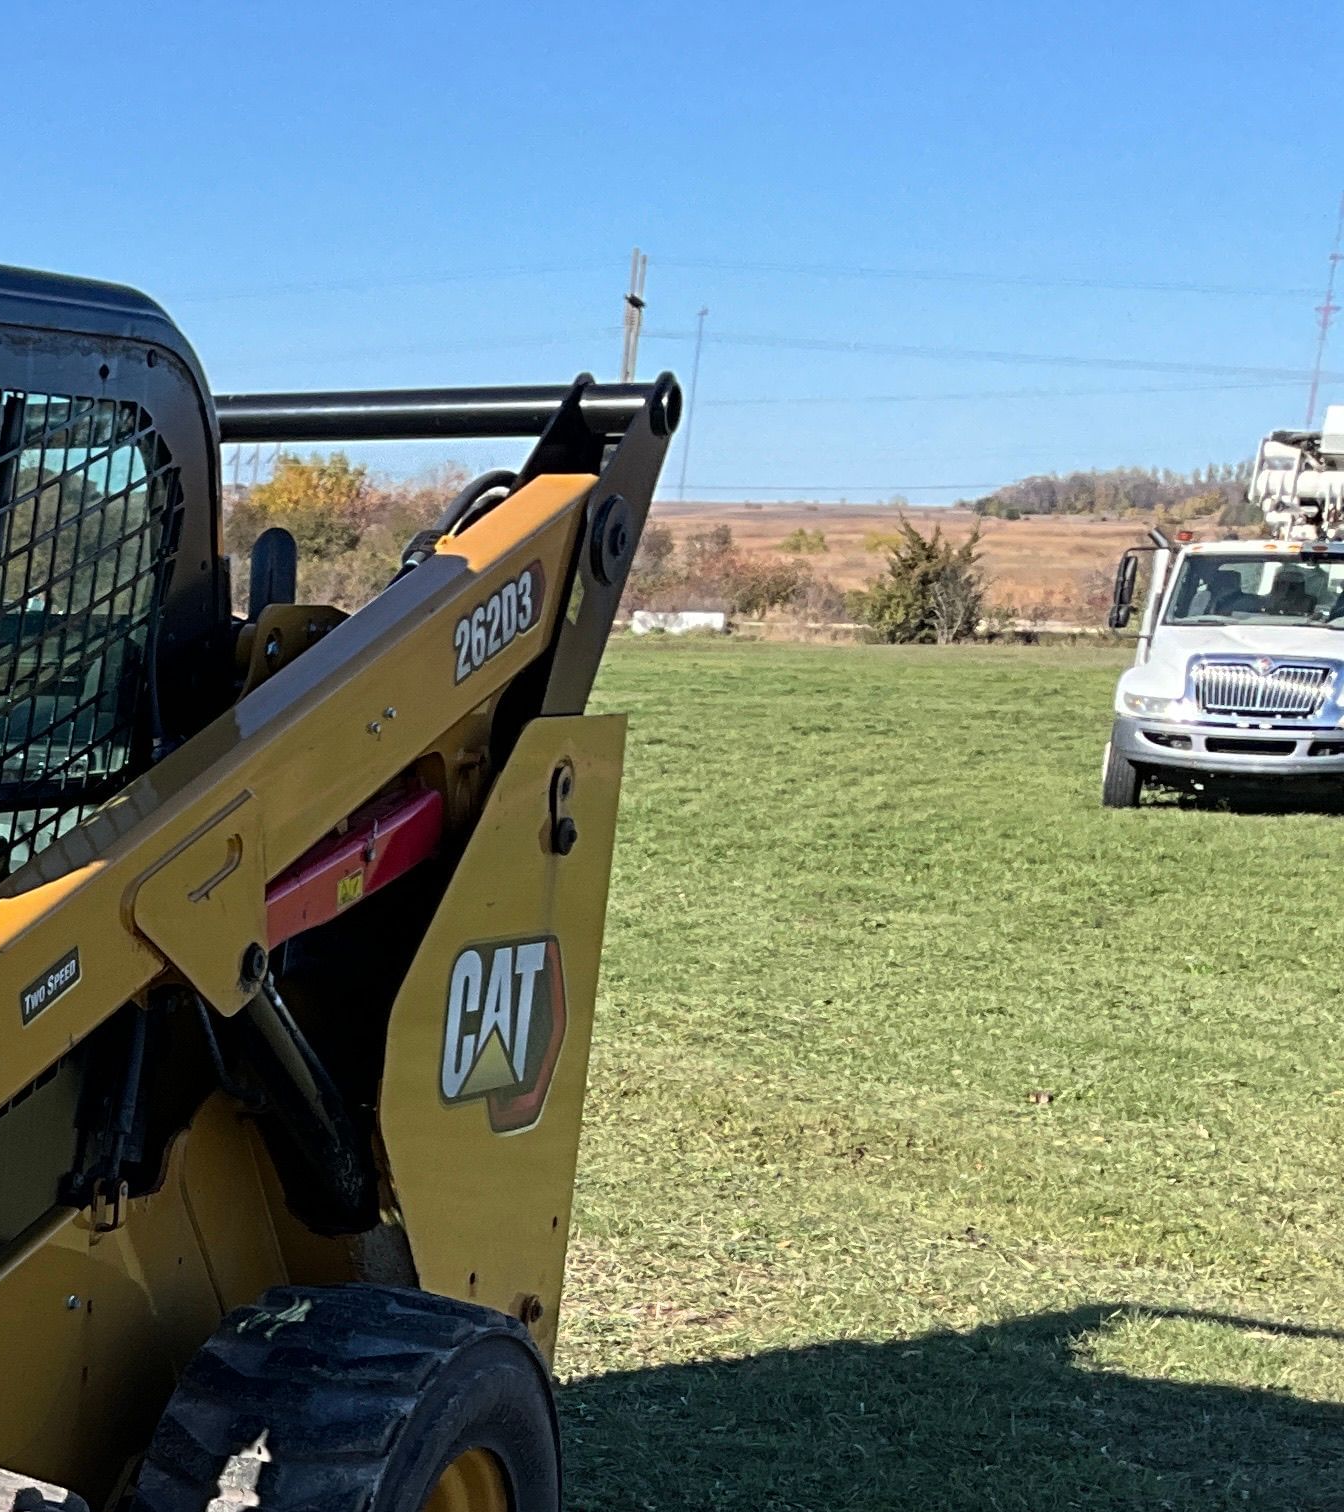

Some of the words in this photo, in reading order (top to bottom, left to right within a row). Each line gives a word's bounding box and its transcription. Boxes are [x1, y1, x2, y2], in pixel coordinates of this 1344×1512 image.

[455, 570, 532, 683] 262D3
[24, 985, 45, 1015] TWO
[47, 959, 76, 995] SPEED
[442, 942, 546, 1098] CAT
